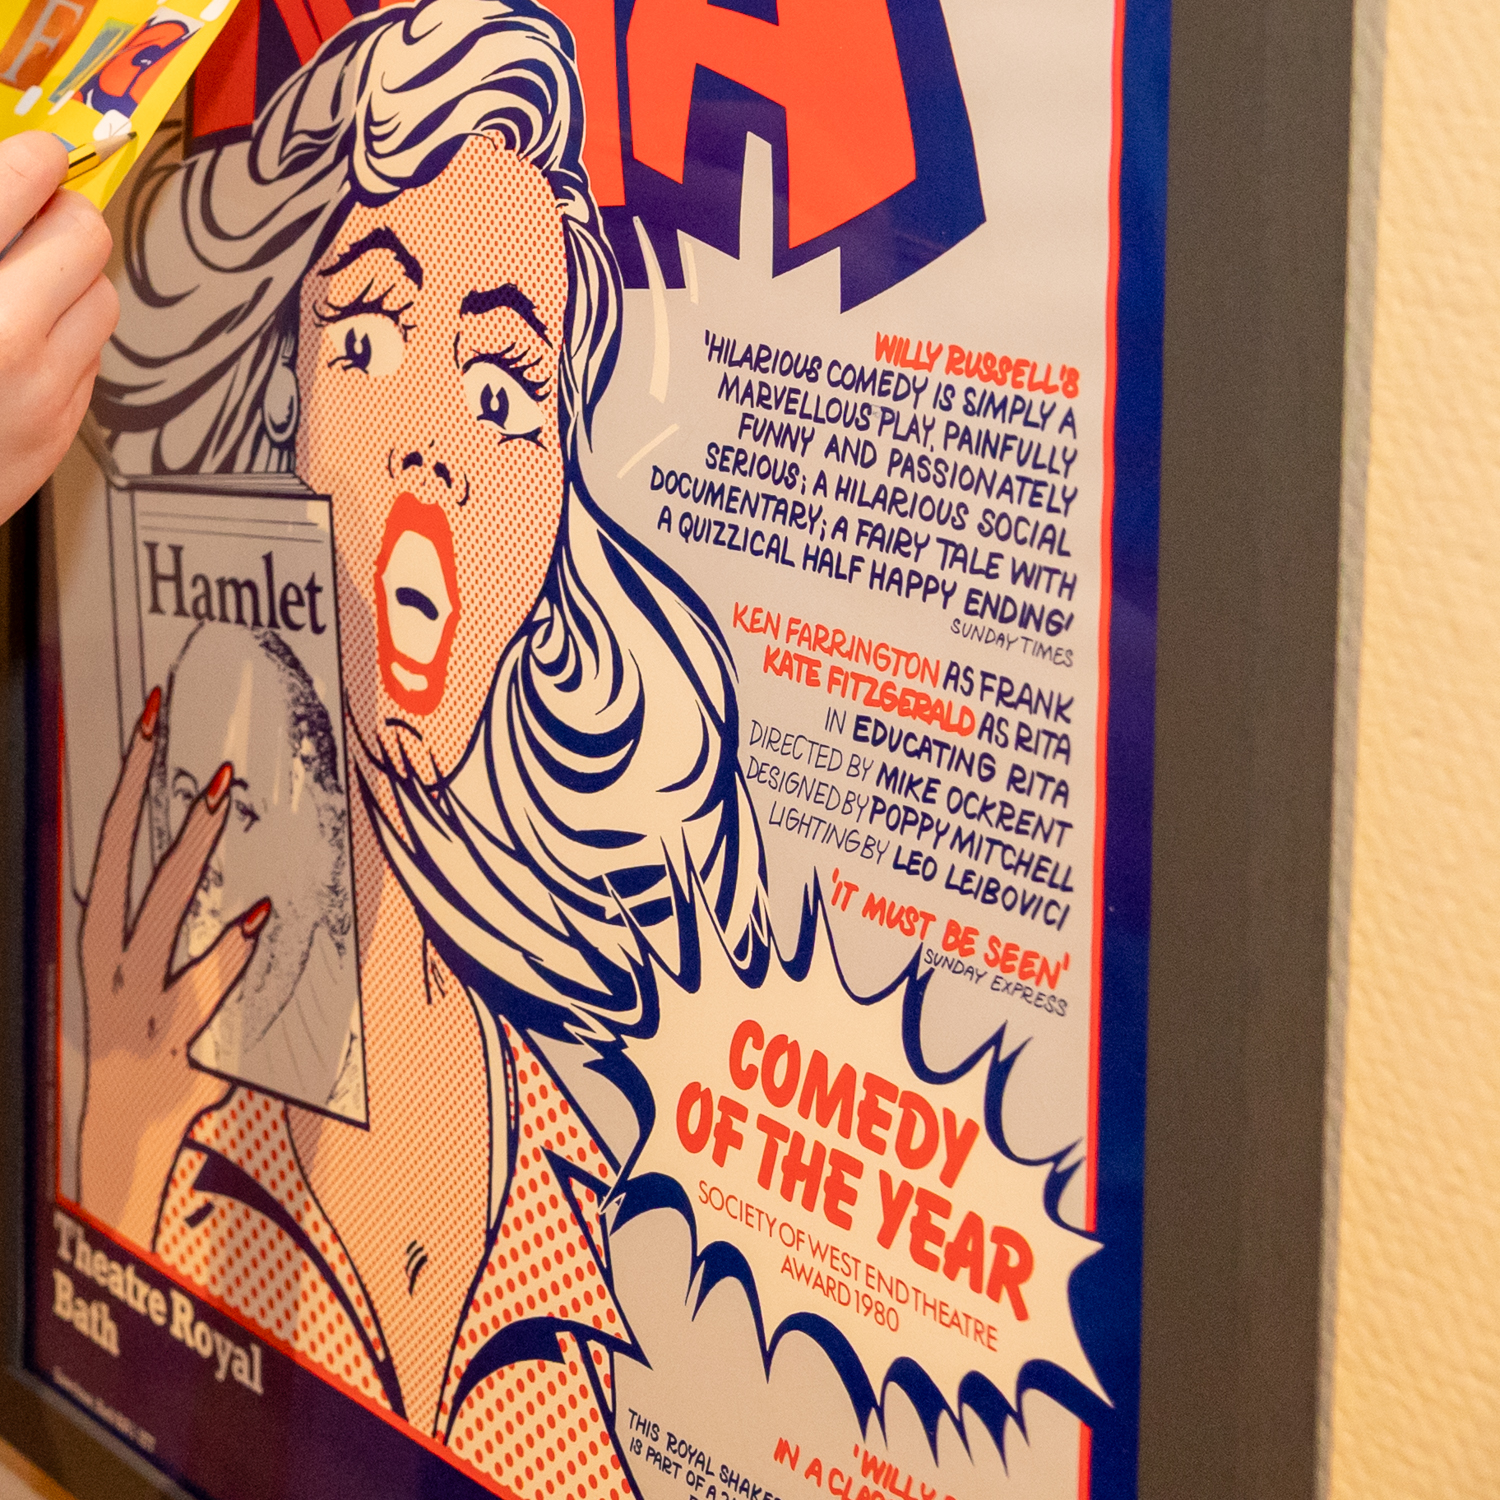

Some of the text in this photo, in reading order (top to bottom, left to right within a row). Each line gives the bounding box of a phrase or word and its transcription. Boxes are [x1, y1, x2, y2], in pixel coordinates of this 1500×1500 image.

[705, 330, 1078, 439] 'HILARIOUS COMEDY IS SIMPLY A
[875, 331, 943, 372] WILLY
[718, 372, 872, 432] MARVELLOUS
[943, 420, 1078, 479] PAINFULLY
[738, 412, 1078, 518] FUNNY AND PASSIONATELY
[657, 505, 673, 533] A
[678, 514, 796, 568] QUIZZICAL
[802, 544, 864, 585] HALF
[869, 561, 958, 611] HAPPY
[812, 469, 828, 499] A
[835, 474, 970, 531] HILARIOUS
[977, 508, 1072, 558] SOCIAL
[830, 515, 849, 542] A
[855, 518, 931, 564] FAIRY
[936, 537, 1004, 581] TALE
[1010, 560, 1078, 601] WITH
[143, 540, 326, 635] Hamlet
[733, 601, 1075, 724] KEN FARRINGTON AS FRANK
[951, 618, 1074, 669] SUNDAY TIMES
[763, 645, 1071, 766] KATE FITZGERALD AS RITA
[825, 706, 1071, 809] IN EDUCATING RITA
[747, 756, 1075, 893] DESIGNED BY POPPY MITCHELL
[748, 719, 1073, 849] DIRECTED BY MIKE OCKRENT
[768, 800, 1071, 932] LIGHTING BY LEO LEIBOVICI
[830, 867, 1071, 991] 'IT MUST BE SEEN'
[923, 948, 1068, 1017] SUNDAY EXPRESS
[729, 1018, 981, 1189] COMEDY
[676, 1081, 1035, 1322] OF THE YEAR
[52, 1269, 120, 1357] Bath
[53, 1211, 263, 1395] Theatre Royal
[698, 1179, 1000, 1353] SOCIETY OF WEST END THEATRE
[780, 1255, 900, 1333] AWARD 1980
[628, 1407, 660, 1443] THIS
[666, 1431, 715, 1478] ROYAL
[629, 1436, 643, 1456] IS
[645, 1446, 682, 1479] PART
[686, 1470, 706, 1492] OF
[773, 1437, 800, 1472] IN
[804, 1457, 822, 1488] A
